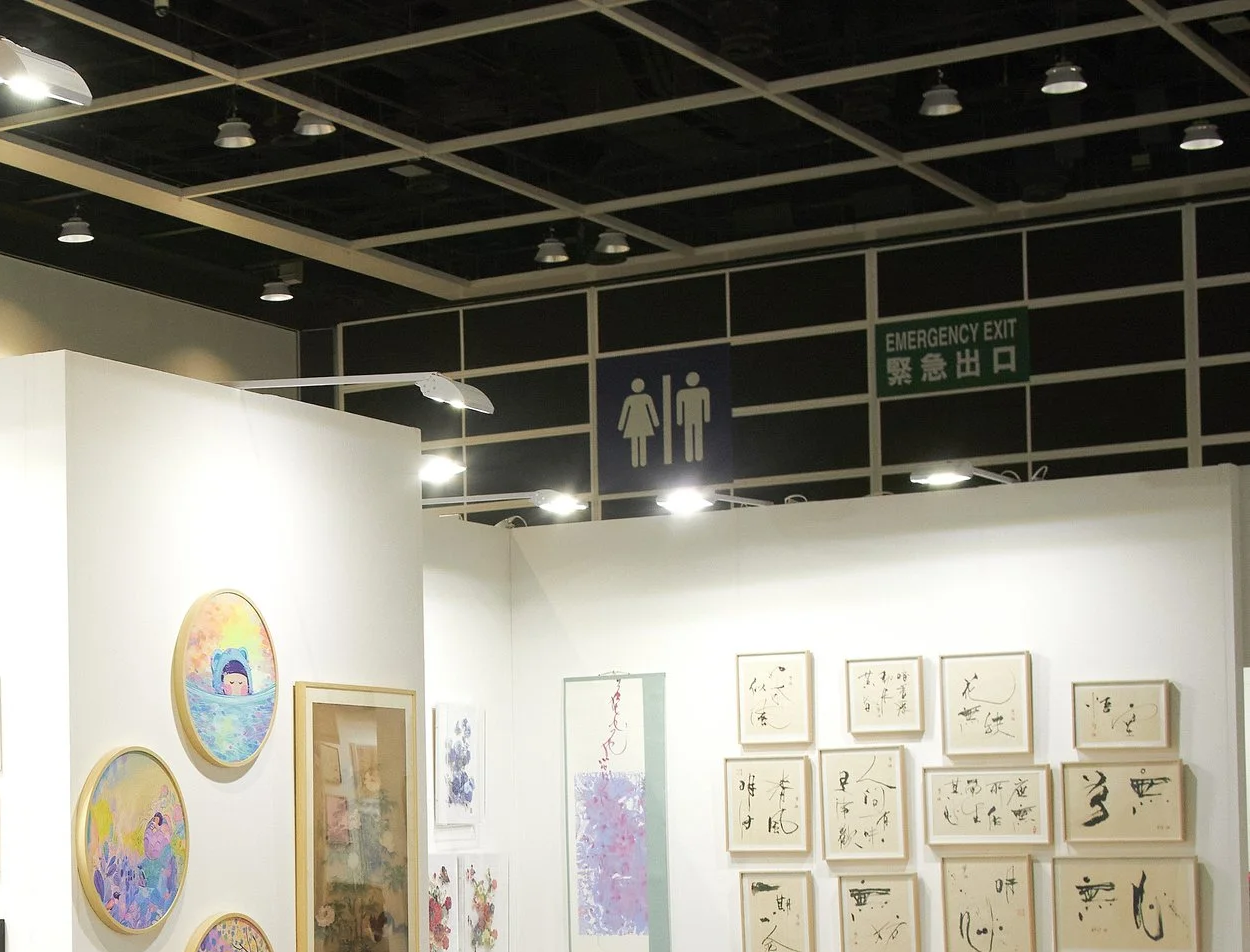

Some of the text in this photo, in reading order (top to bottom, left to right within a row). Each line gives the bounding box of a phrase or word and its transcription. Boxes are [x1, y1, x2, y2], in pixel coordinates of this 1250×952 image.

[885, 317, 1017, 352] EMERGENCY EXIT
[886, 345, 1017, 386] 緊急出口
